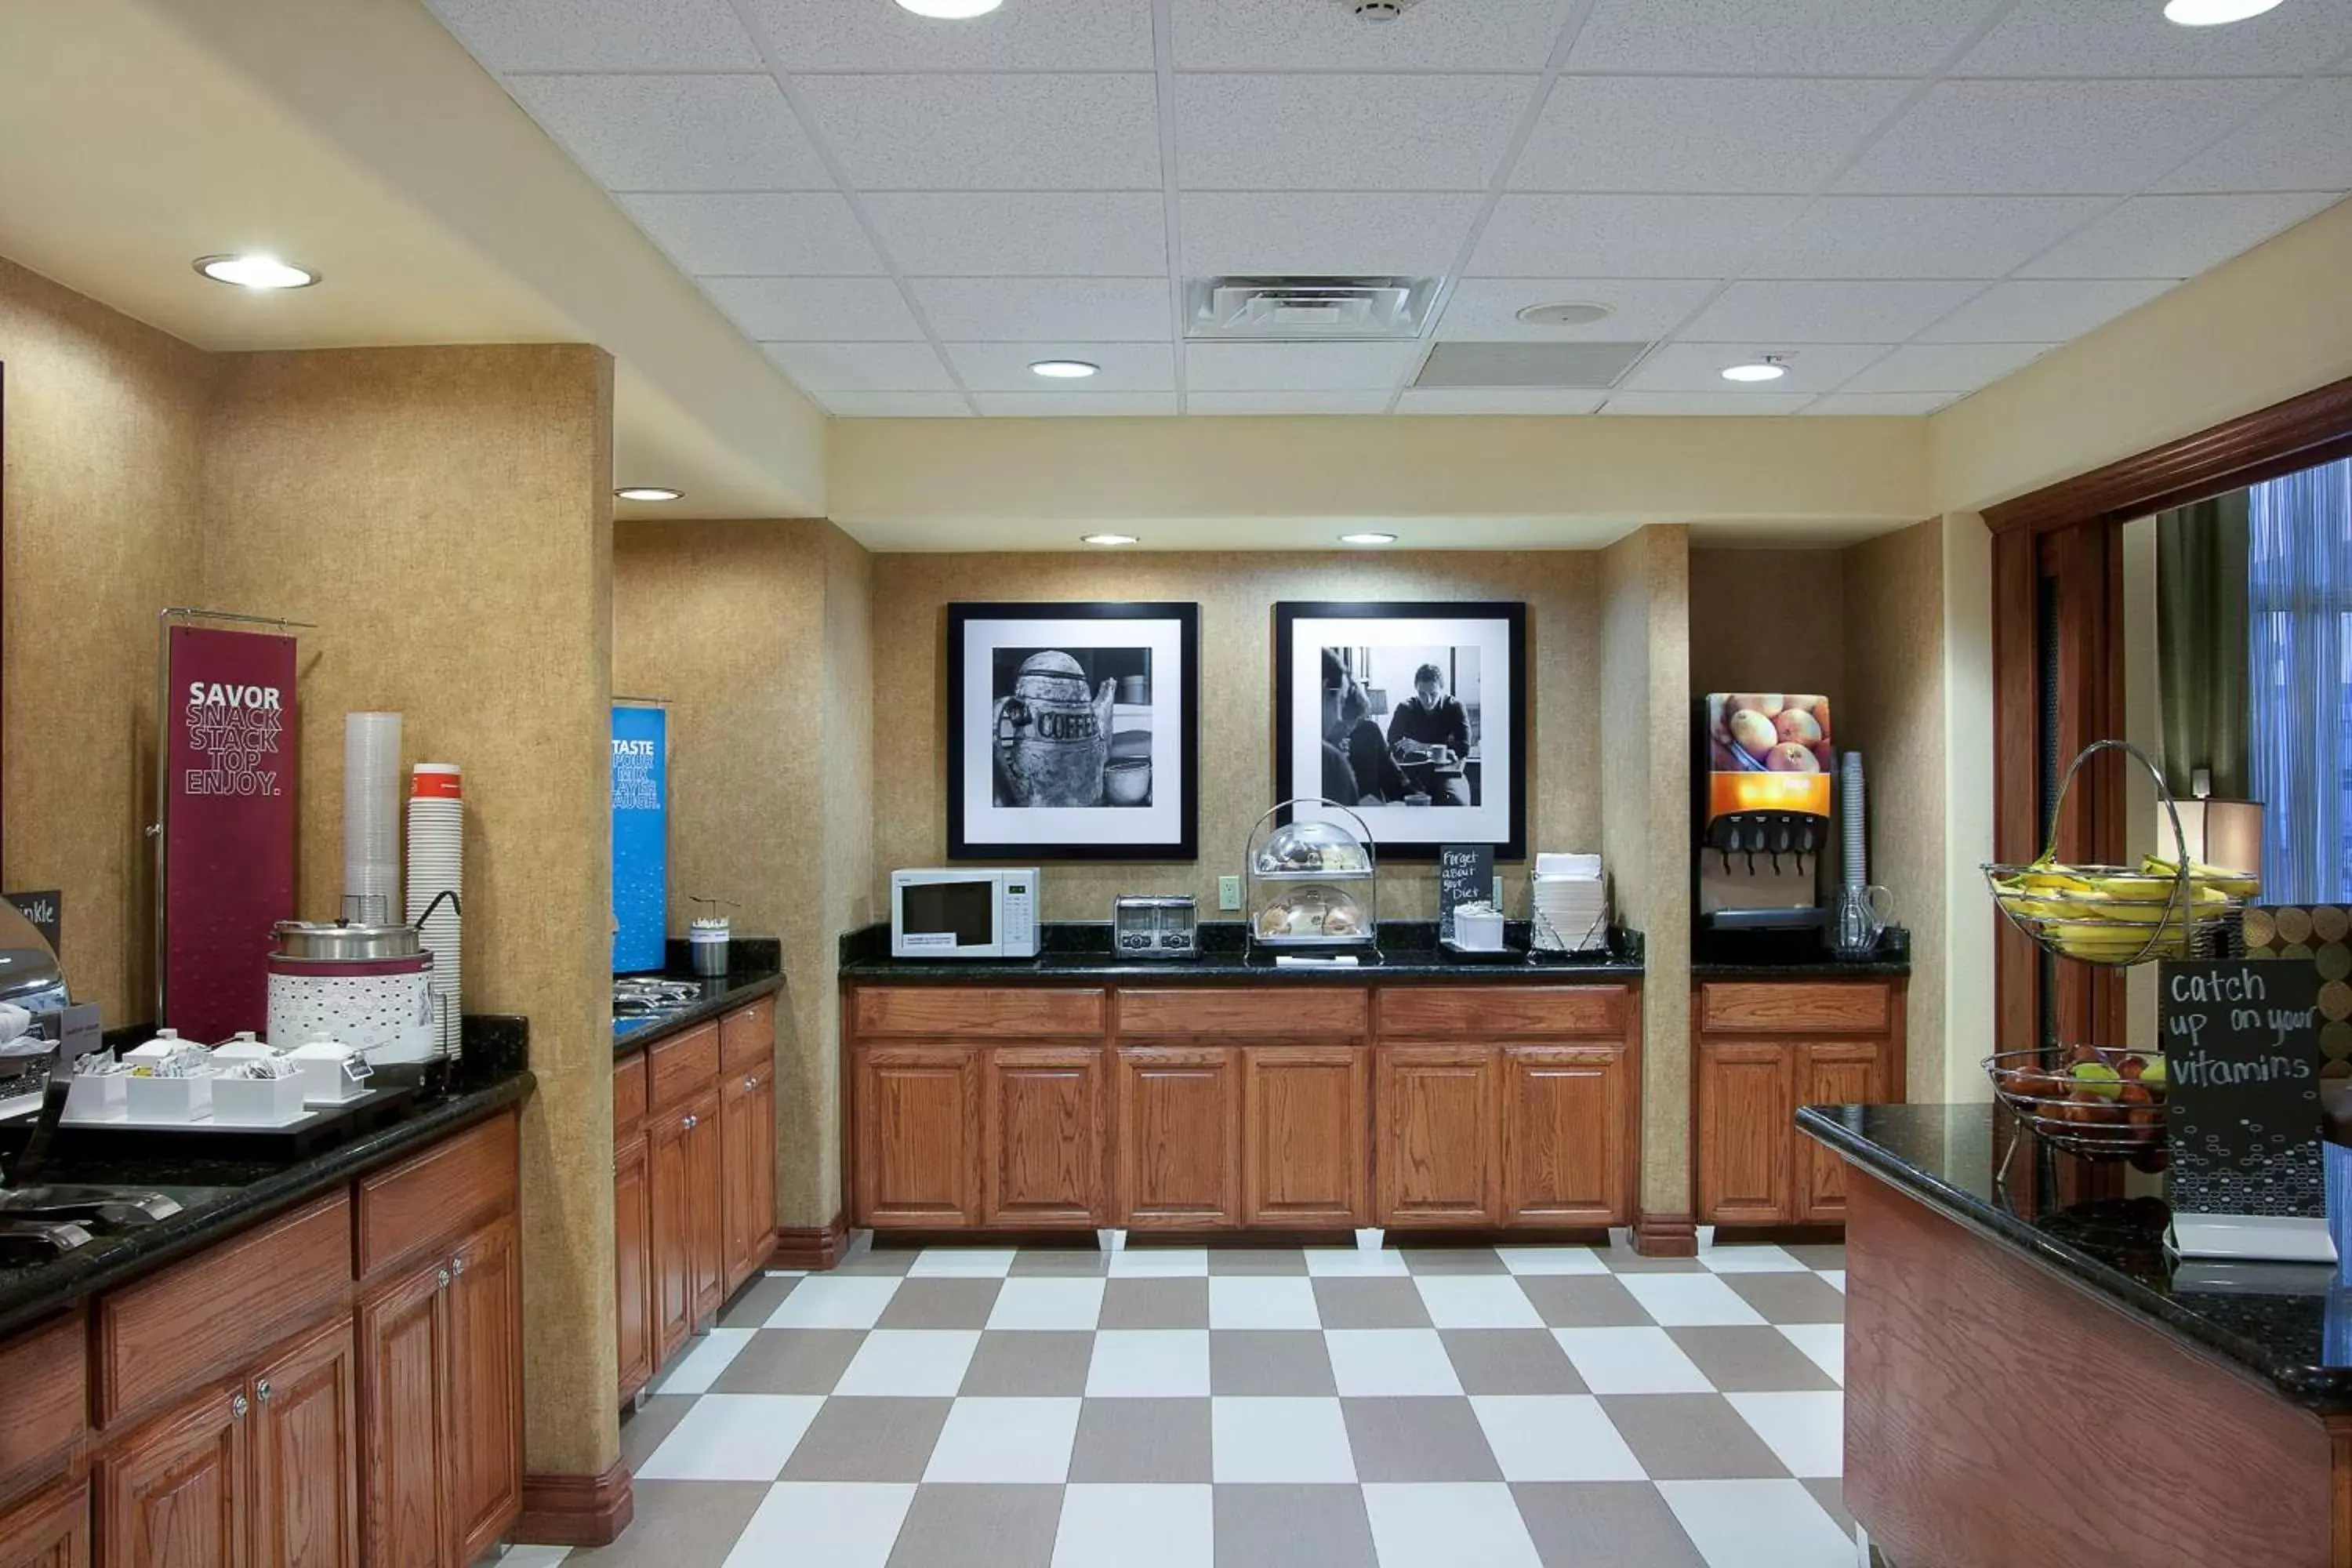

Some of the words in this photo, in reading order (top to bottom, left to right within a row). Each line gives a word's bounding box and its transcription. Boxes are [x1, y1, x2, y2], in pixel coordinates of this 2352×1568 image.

[189, 681, 280, 710] SAVOR
[186, 703, 283, 731] SNACK
[190, 725, 279, 753] STACK
[612, 739, 654, 755] TASTE
[208, 748, 261, 773] TOP
[185, 769, 281, 796] ENJOY.
[2171, 967, 2266, 1002] catch
[2169, 1013, 2209, 1046] up
[2230, 1008, 2262, 1031] on
[2267, 1005, 2318, 1047] your
[2172, 1049, 2310, 1088] vitamins
